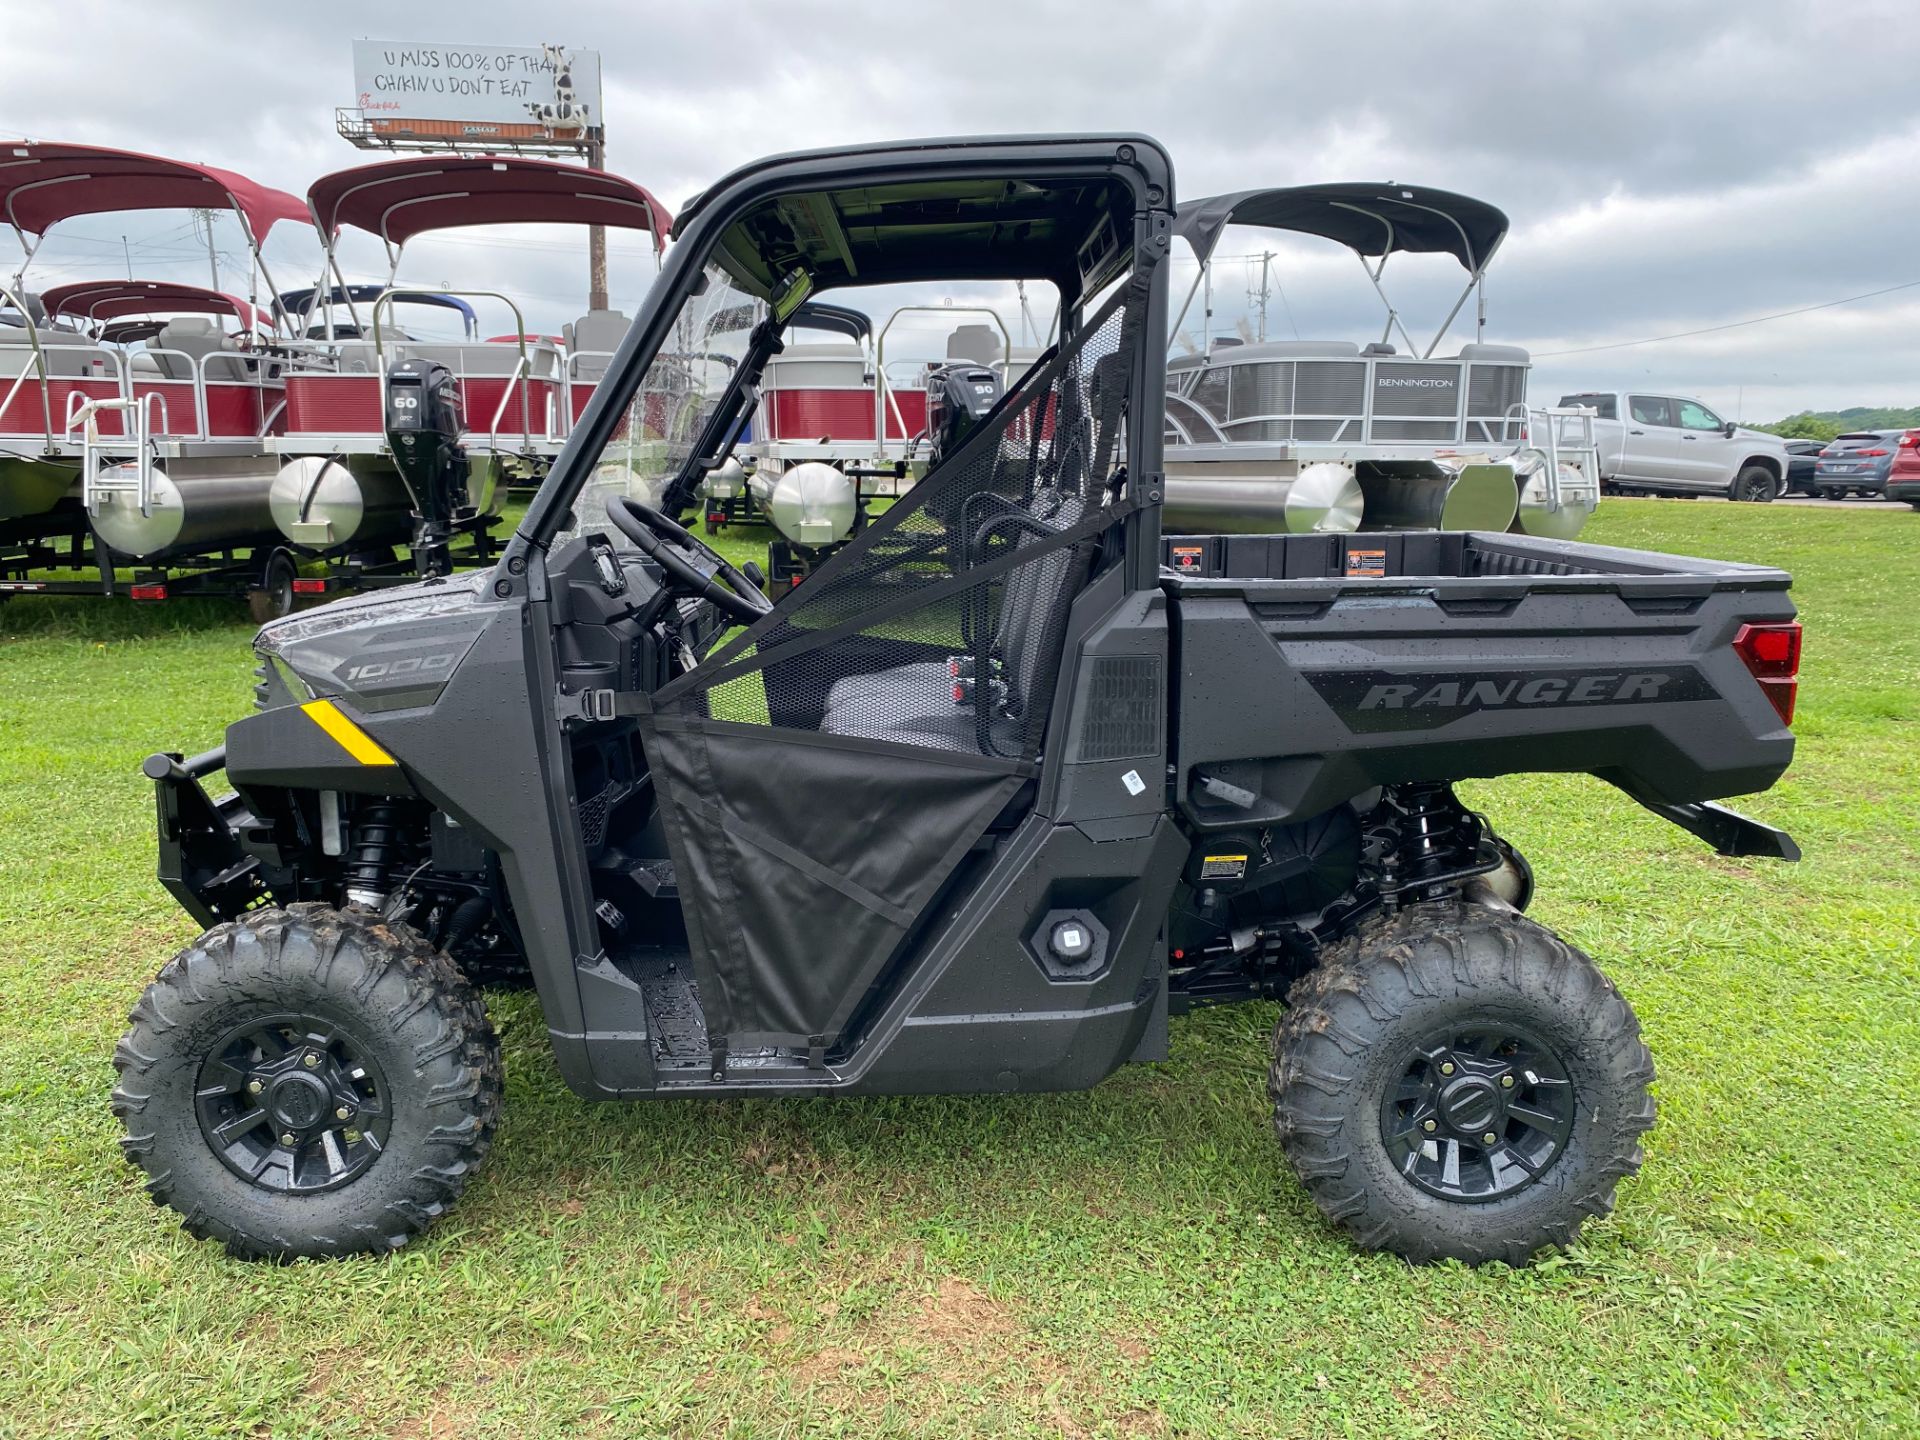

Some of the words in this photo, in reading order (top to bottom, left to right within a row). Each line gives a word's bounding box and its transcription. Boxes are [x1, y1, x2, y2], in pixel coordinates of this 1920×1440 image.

[384, 51, 395, 65] U
[401, 49, 440, 68] MISS
[445, 52, 490, 71] 100%
[495, 55, 516, 72] OF
[375, 74, 429, 92] CHIKIN
[432, 78, 444, 93] U
[449, 75, 495, 95] DON'T
[500, 79, 532, 97] EAT
[974, 385, 994, 395] 90
[1379, 378, 1454, 388] BENNINGTON
[394, 397, 418, 409] 60
[347, 653, 456, 681] 1000
[1357, 673, 1671, 710] RANGER
